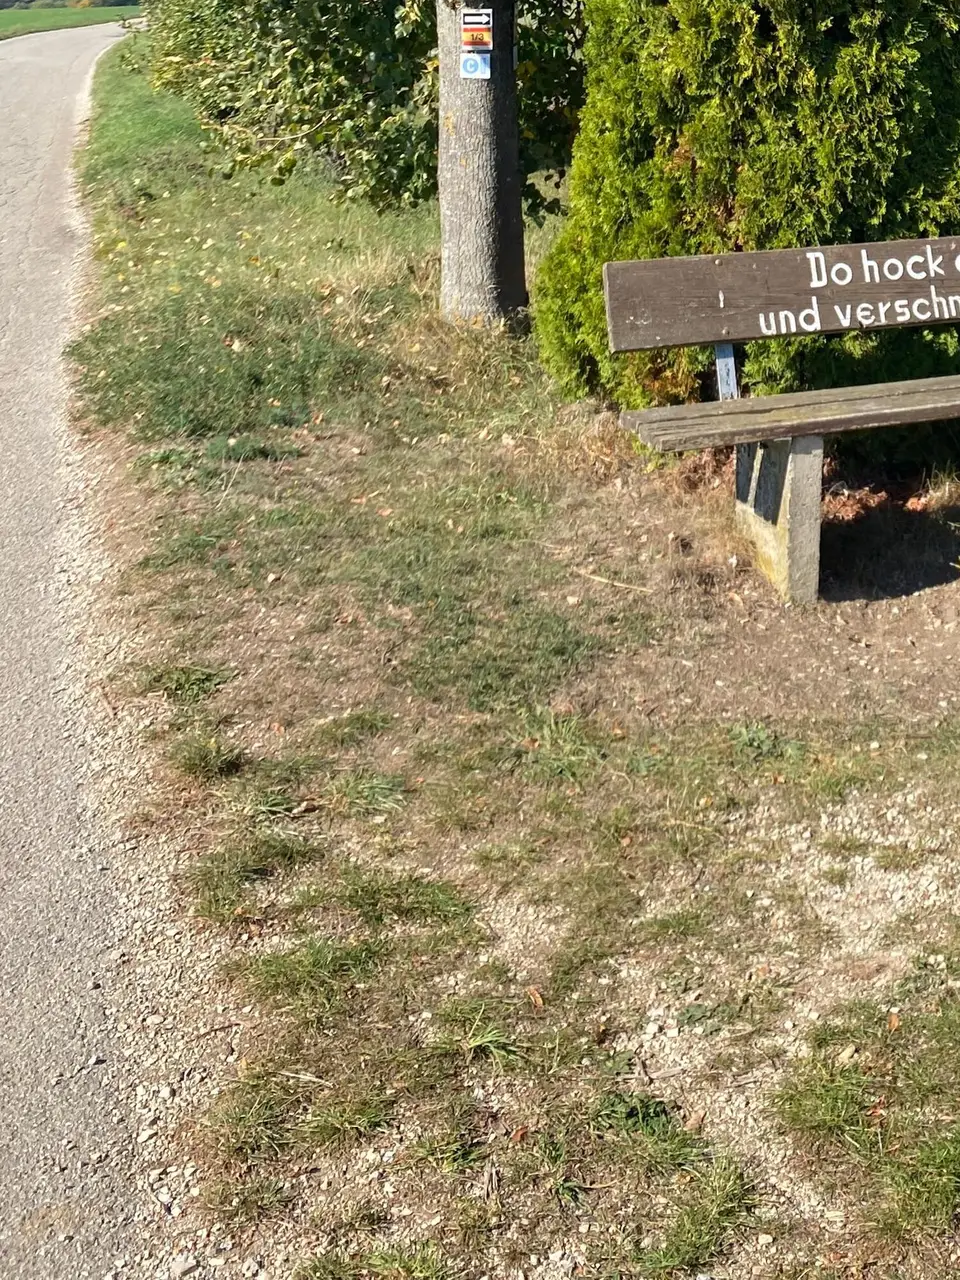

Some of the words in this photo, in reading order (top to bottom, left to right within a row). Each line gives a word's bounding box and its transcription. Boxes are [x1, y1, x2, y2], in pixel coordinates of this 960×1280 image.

[470, 33, 484, 41] 1/3
[806, 251, 853, 288] Do
[860, 244, 945, 283] hock
[758, 295, 822, 336] und
